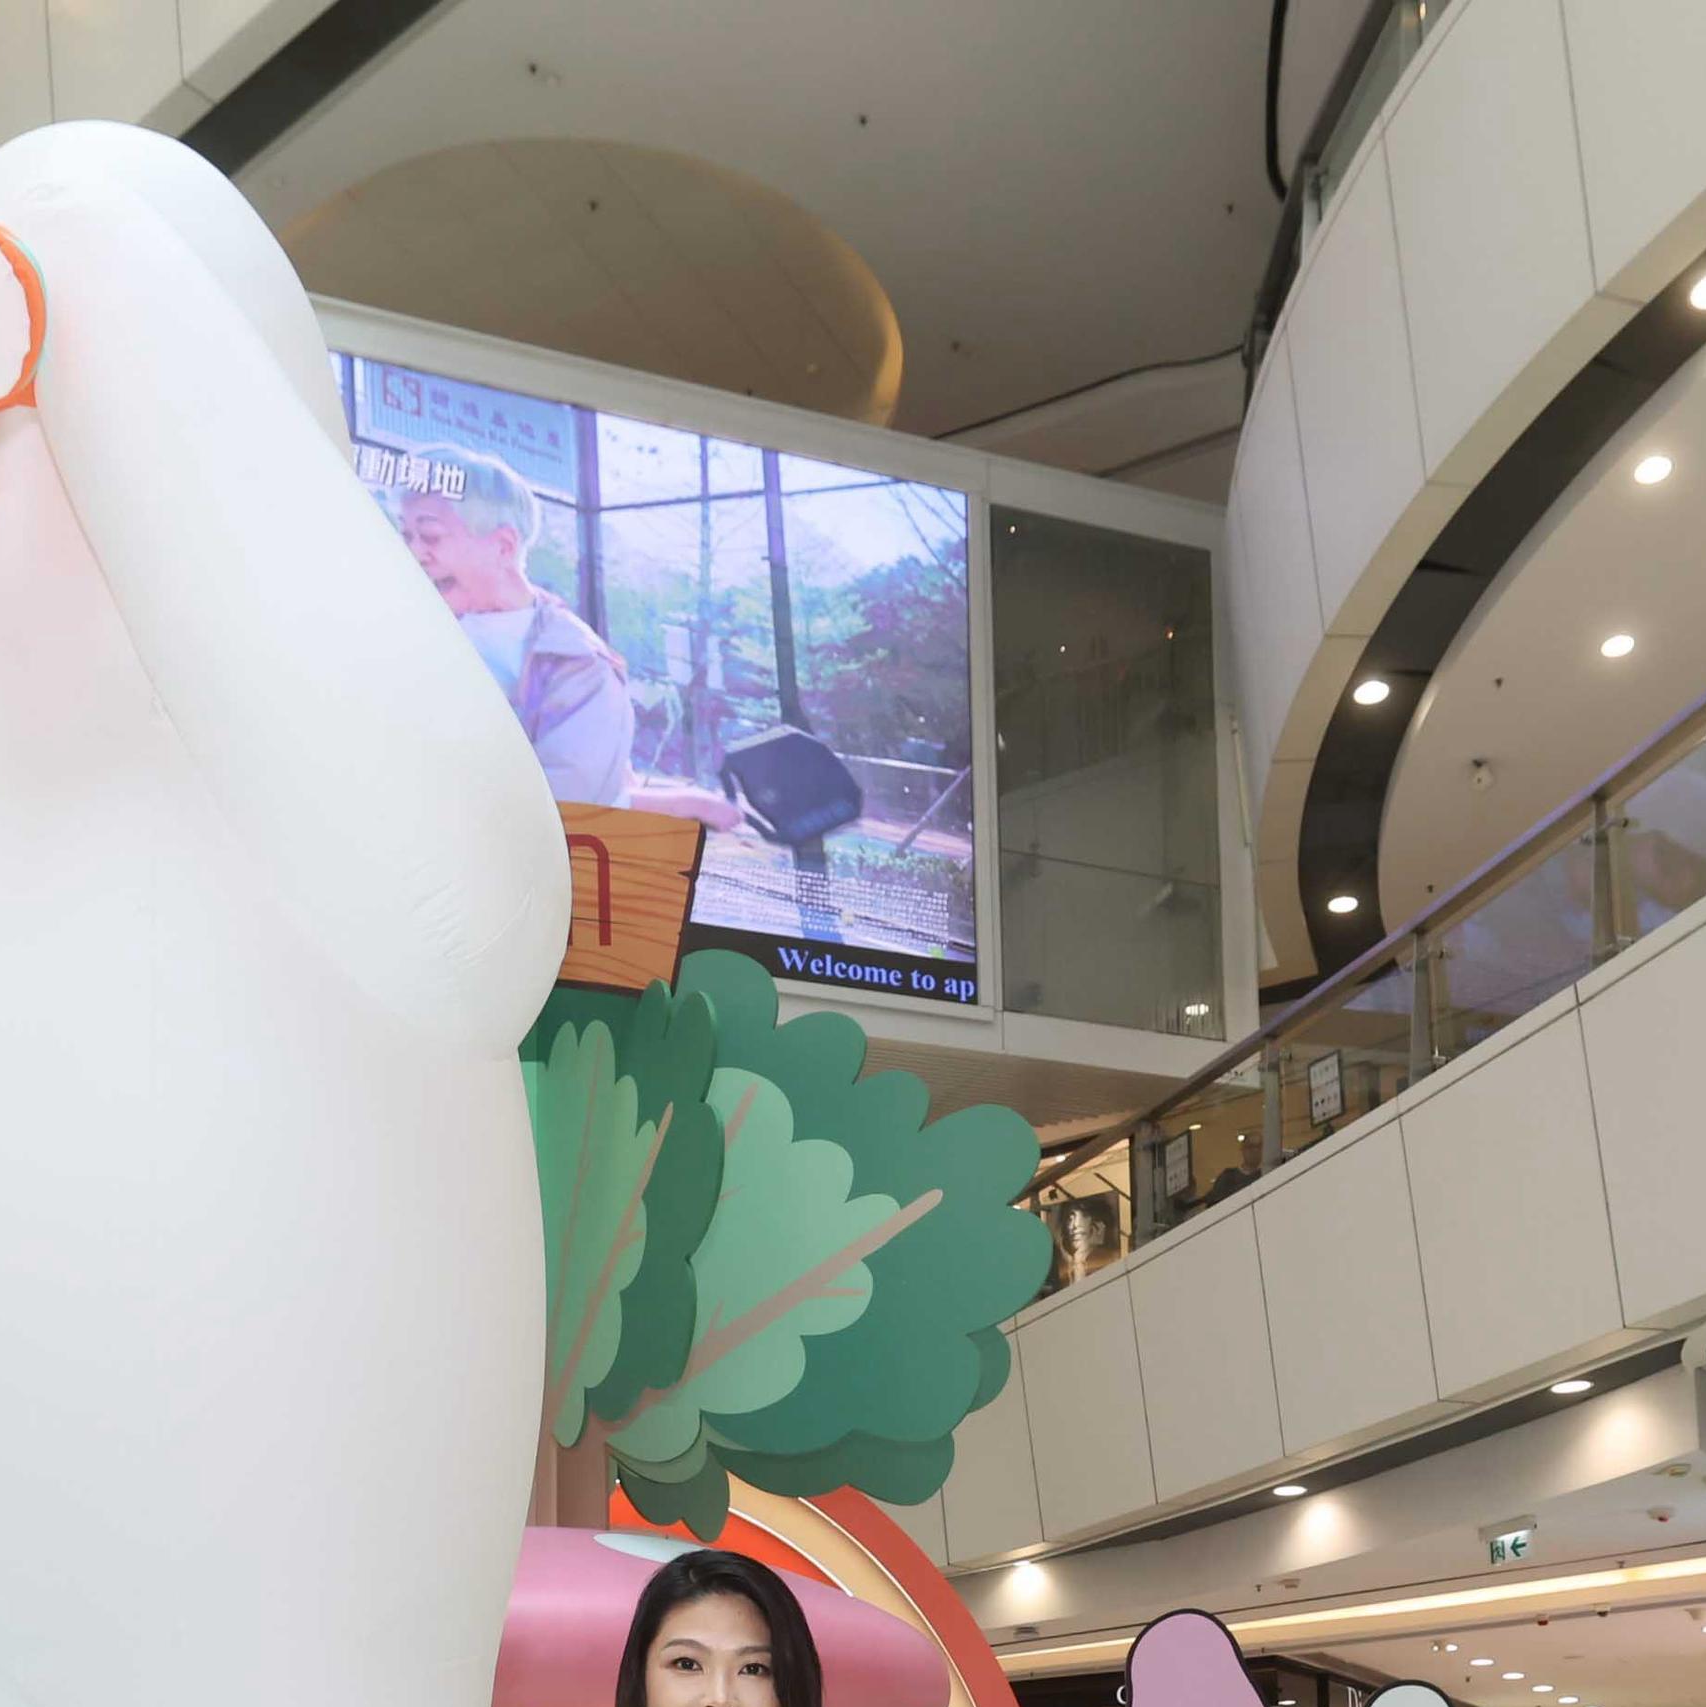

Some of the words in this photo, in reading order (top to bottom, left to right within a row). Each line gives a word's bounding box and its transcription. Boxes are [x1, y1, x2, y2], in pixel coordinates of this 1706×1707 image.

[354, 446, 466, 501] 動場地
[777, 946, 903, 987] Welcome
[910, 968, 936, 991] to
